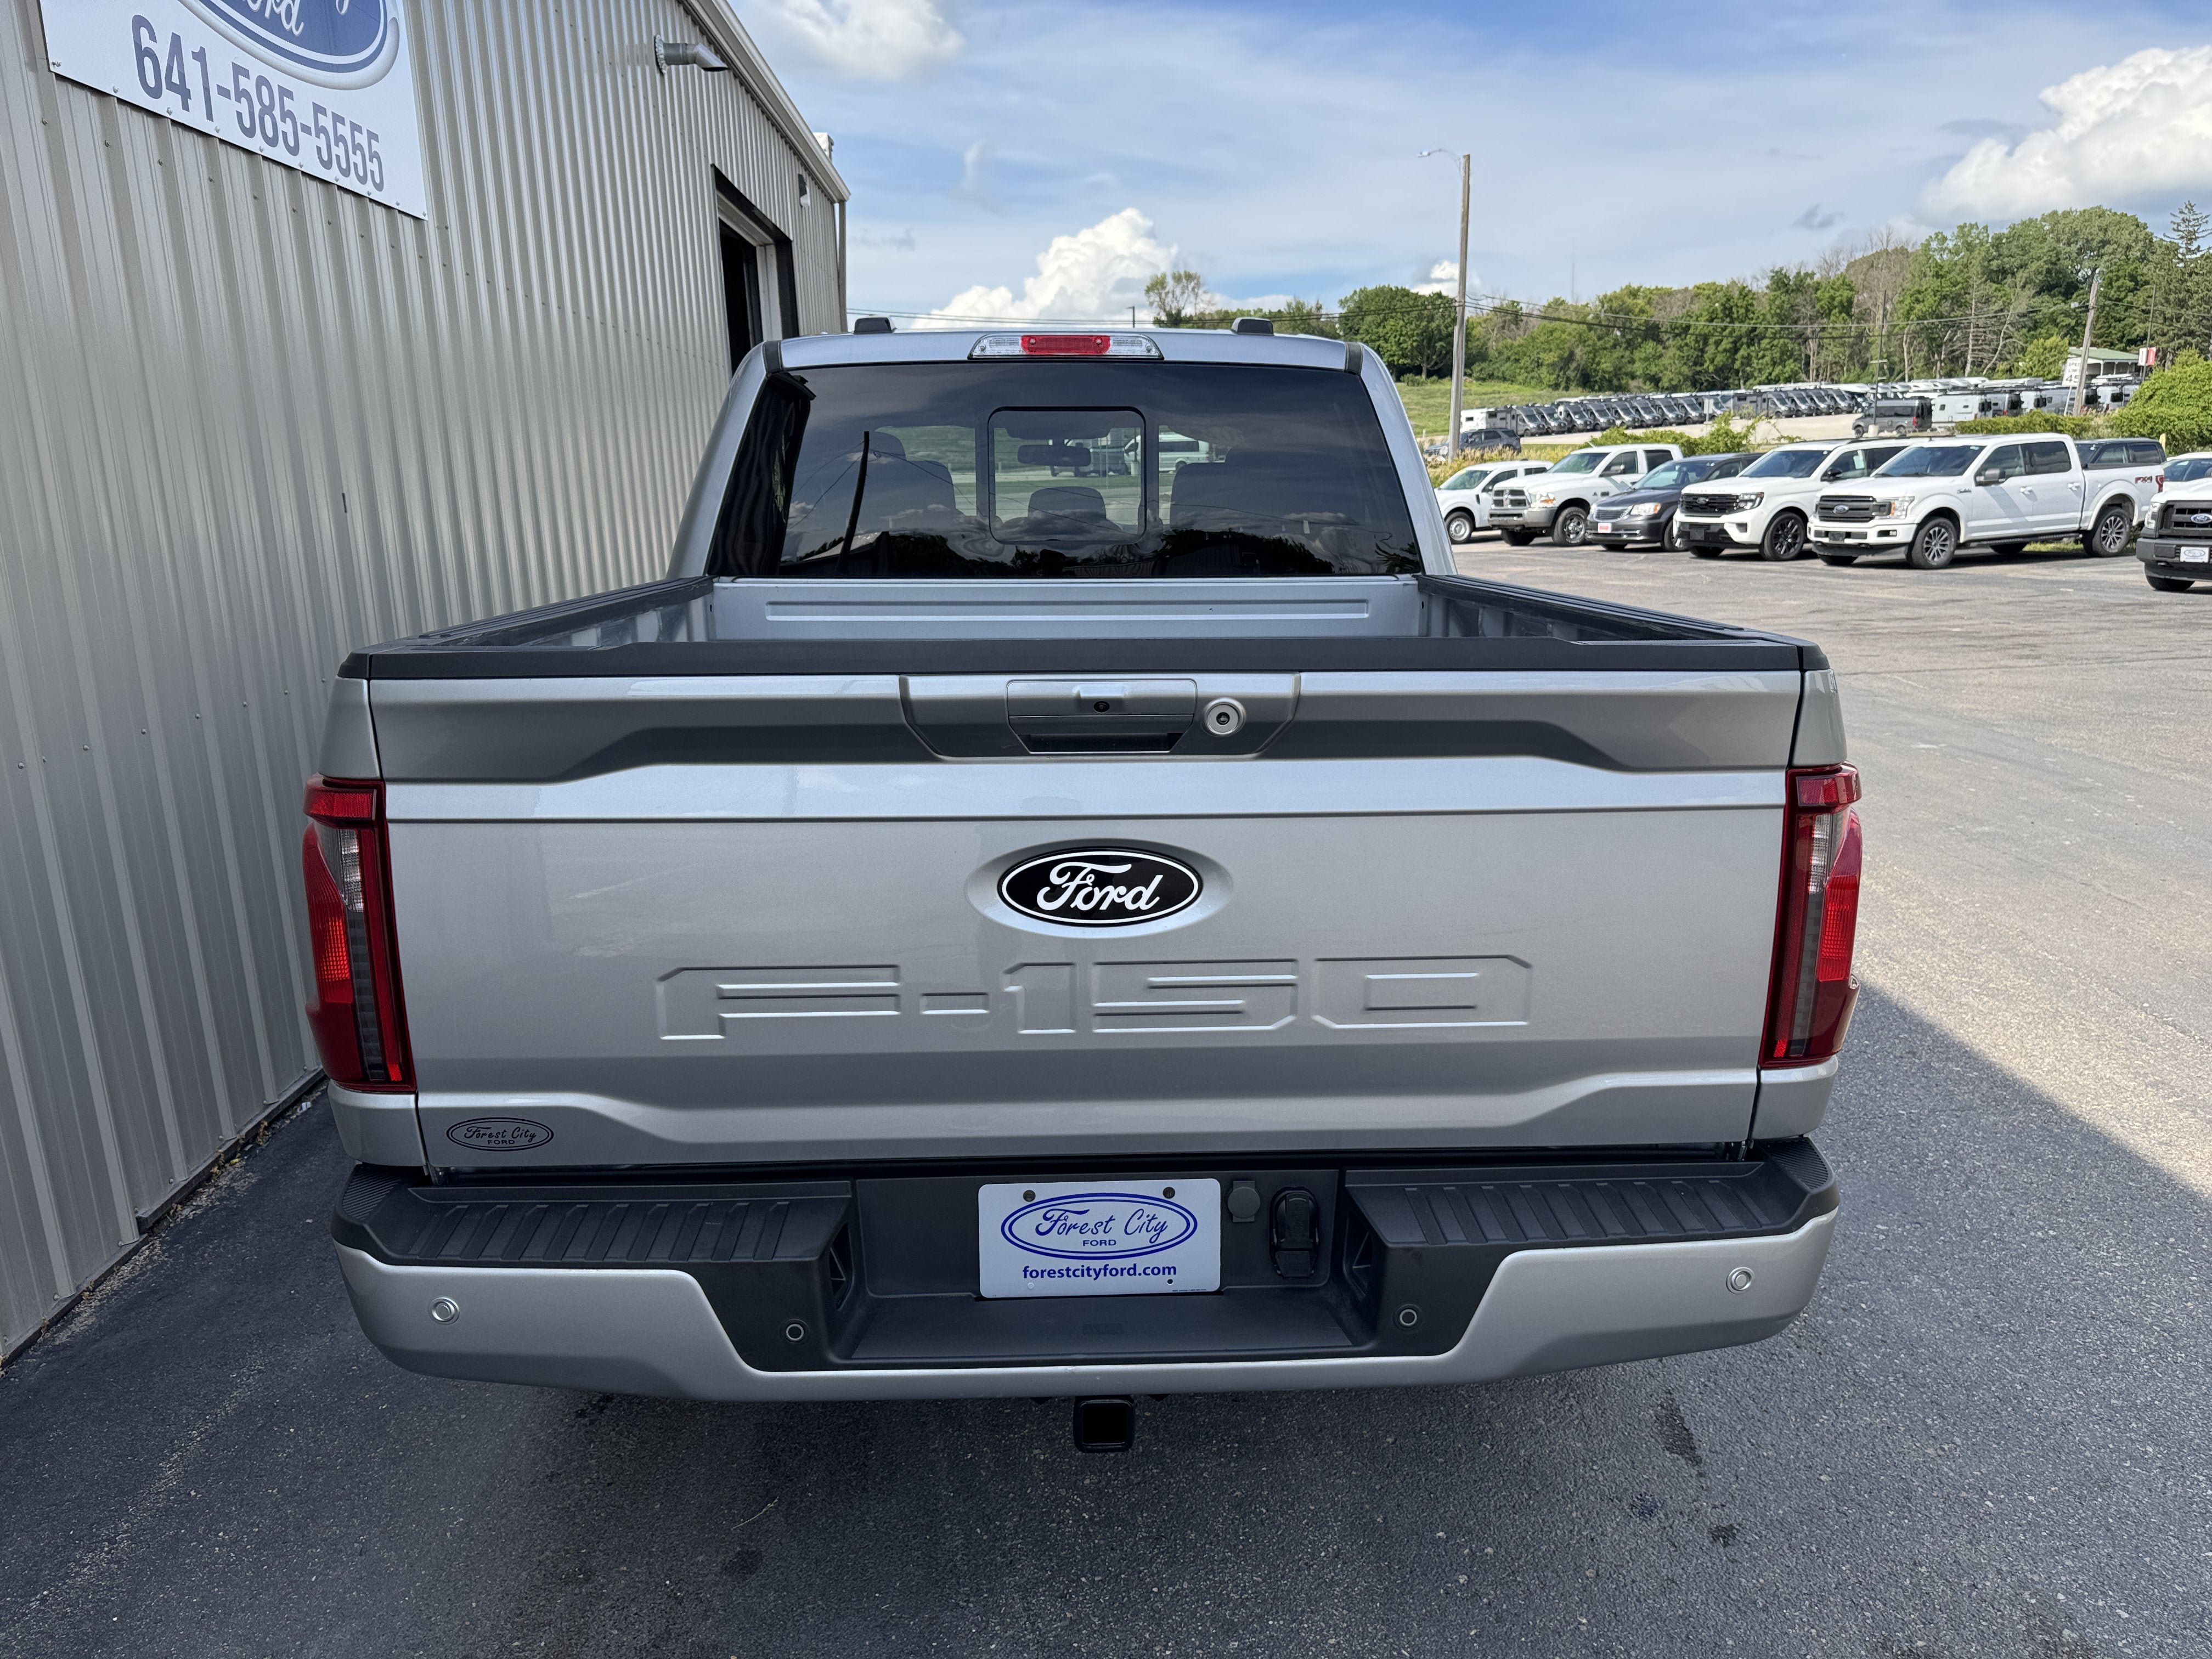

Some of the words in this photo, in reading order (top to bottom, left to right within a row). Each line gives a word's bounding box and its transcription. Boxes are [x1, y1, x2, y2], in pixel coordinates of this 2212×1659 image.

[132, 15, 384, 192] 641-585-5555
[2066, 374, 2080, 383] 45
[1036, 862, 1164, 911] Ford
[657, 955, 1532, 1041] F-150
[464, 1126, 507, 1138] Forest
[511, 1127, 537, 1143] City
[1035, 1208, 1116, 1235] Forest
[1124, 1209, 1168, 1244] City
[1022, 1263, 1177, 1280] forestcityford.com
